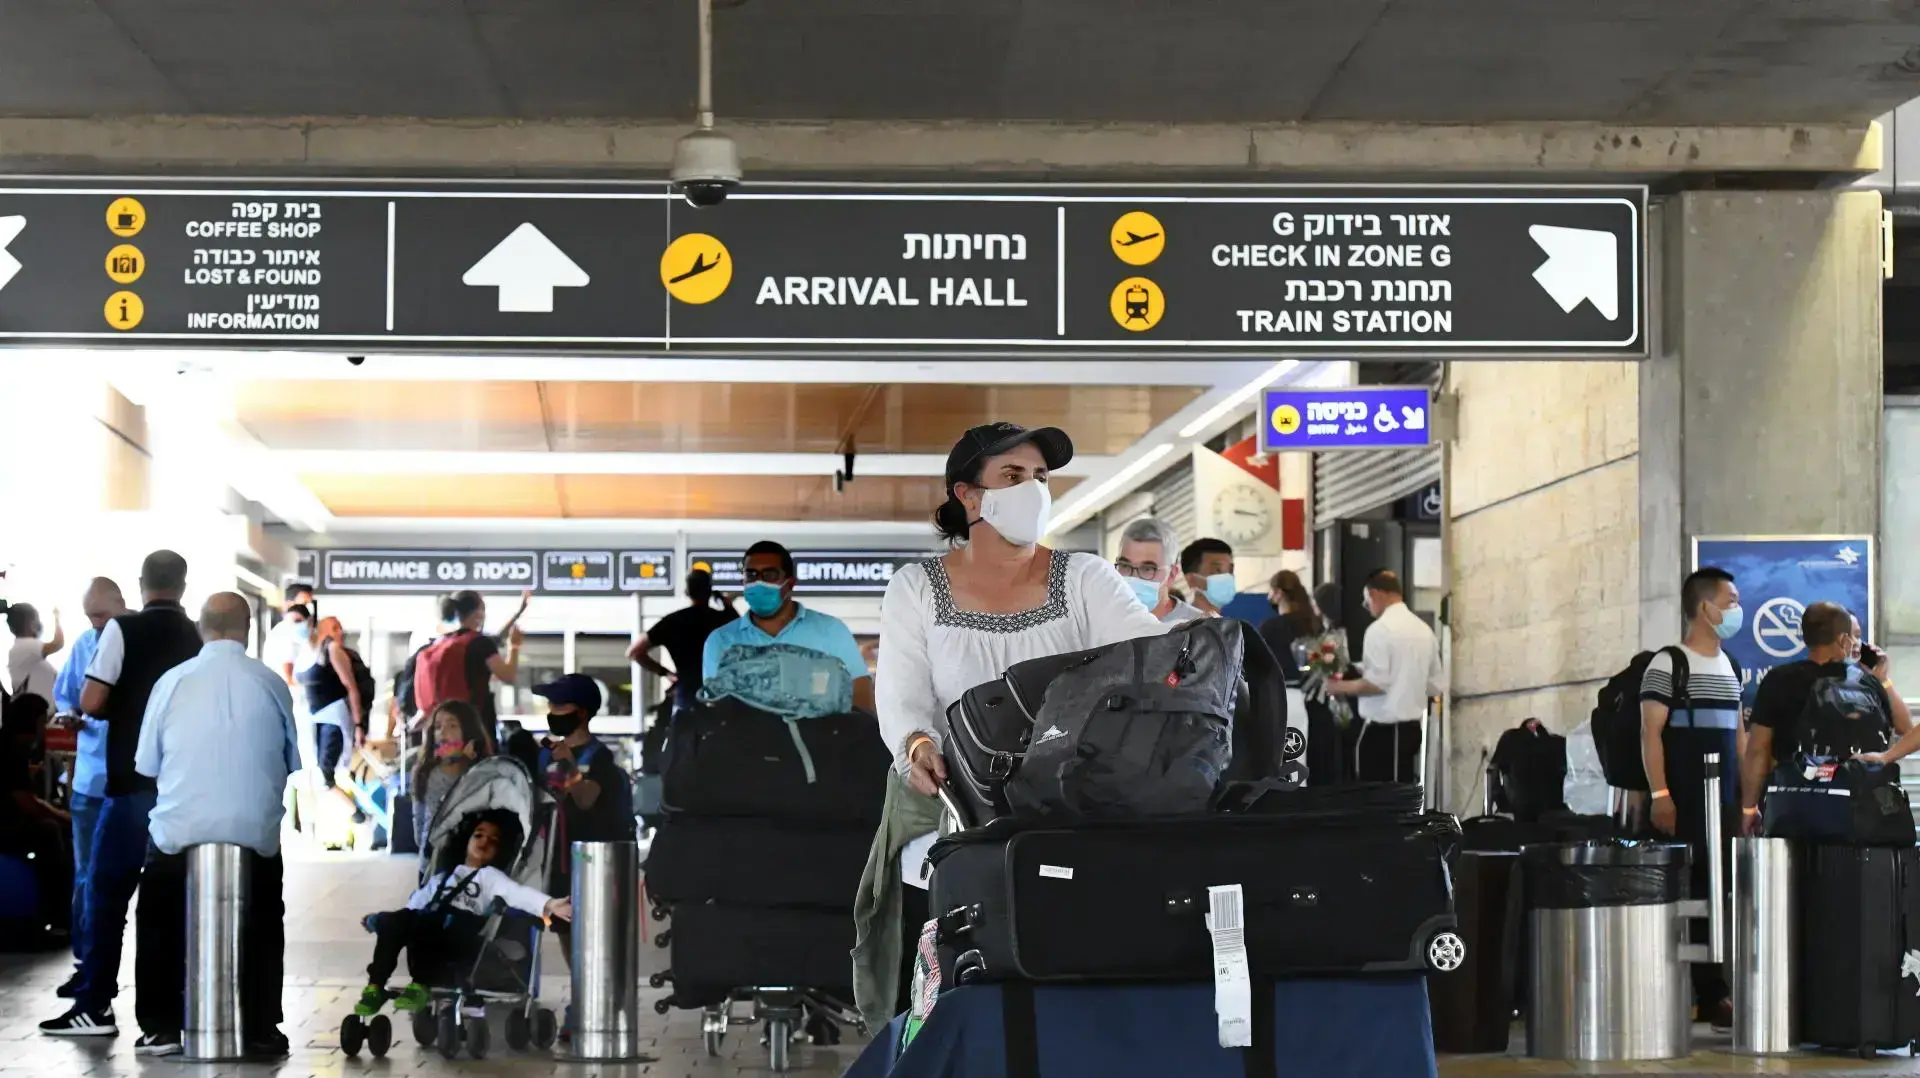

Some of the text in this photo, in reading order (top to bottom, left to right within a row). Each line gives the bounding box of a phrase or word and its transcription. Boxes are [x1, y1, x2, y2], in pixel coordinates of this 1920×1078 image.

[231, 202, 321, 222] בית קפה
[185, 221, 322, 238] COFFEE SHOP
[1272, 212, 1451, 242] אזור בידוק G
[902, 233, 1027, 260] נחיתות
[1211, 244, 1452, 267] CHECK IN ZONE G
[193, 249, 321, 265] איתור כבודה
[184, 269, 322, 285] LOST & FOUND
[755, 276, 1029, 307] ARRIVAL HALL
[1284, 279, 1452, 302] תחנת רכבת
[247, 294, 320, 313] מודיעין
[187, 313, 320, 330] INFORMATION
[1236, 310, 1452, 333] TRAIN STATION
[1306, 401, 1368, 421] כניסה
[331, 560, 532, 581] ENTRANCE 03 כניסה
[796, 562, 894, 581] ENTRANCE
